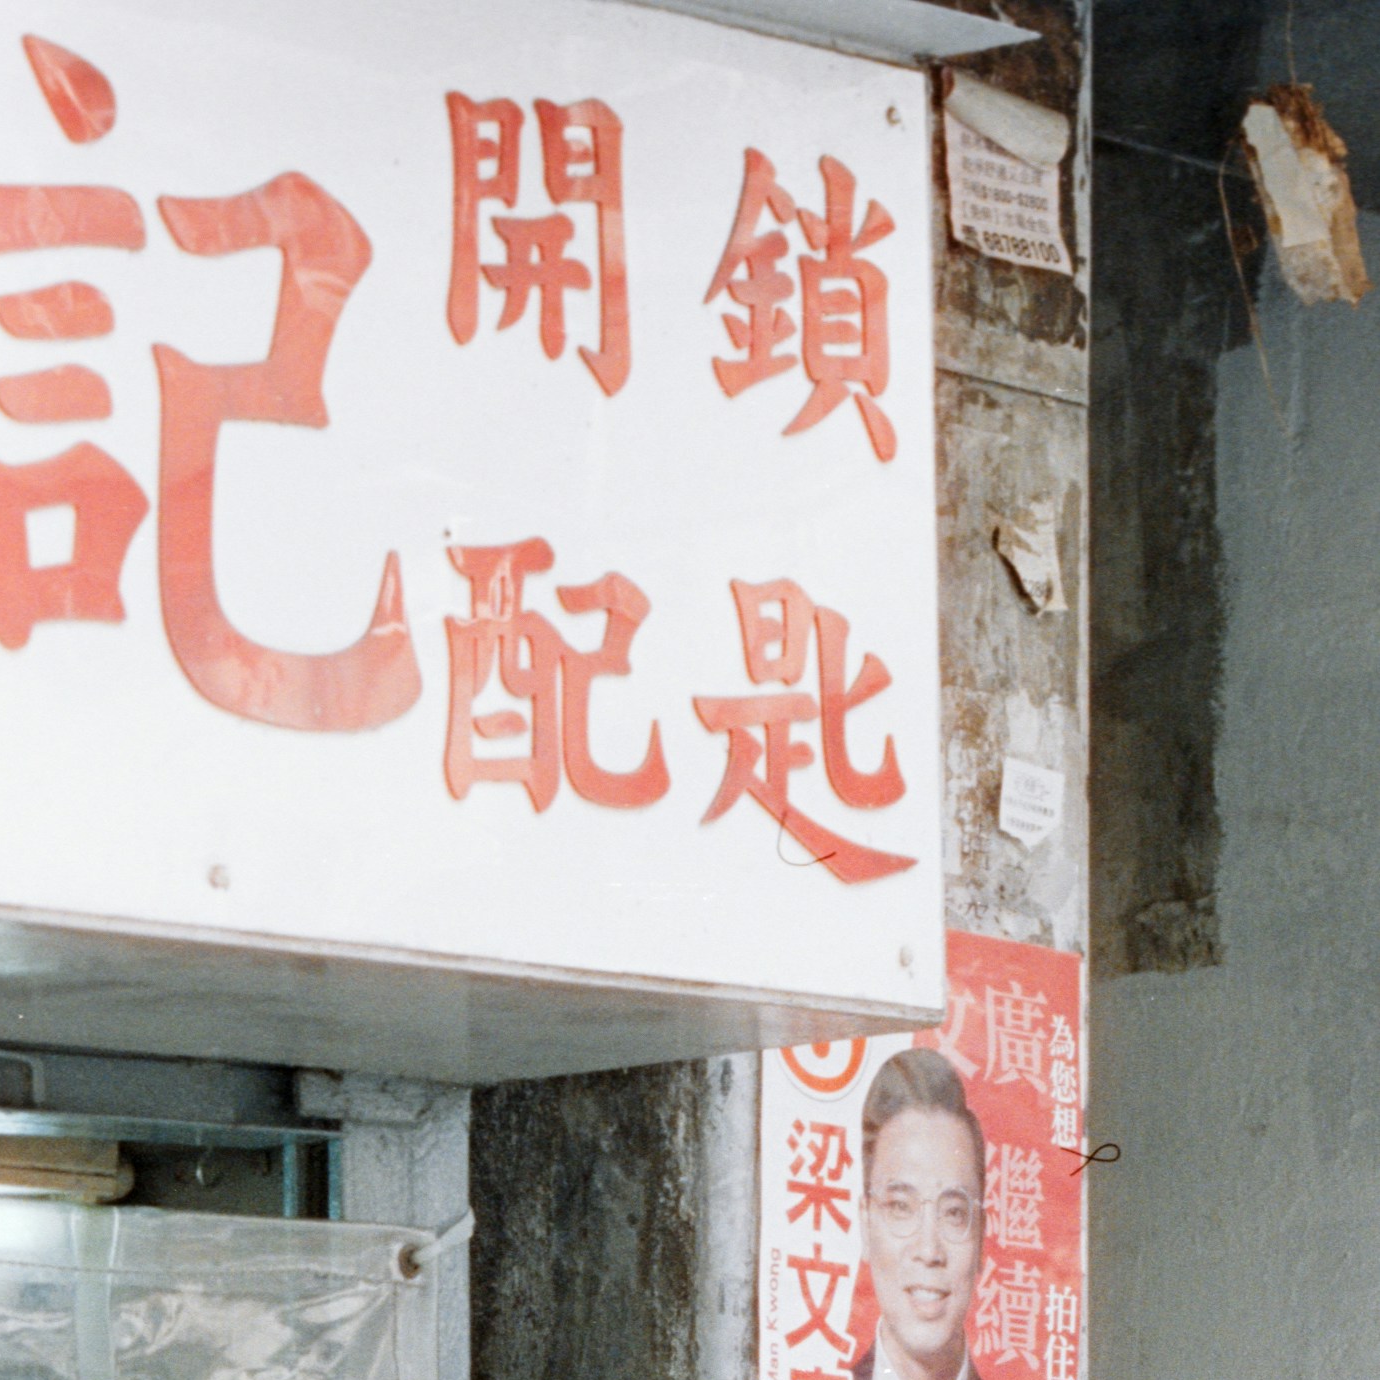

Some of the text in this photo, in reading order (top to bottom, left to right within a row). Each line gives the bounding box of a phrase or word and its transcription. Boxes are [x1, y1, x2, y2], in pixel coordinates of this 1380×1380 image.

[444, 91, 897, 464] 開鎖
[443, 536, 919, 884] 配匙
[1049, 1015, 1077, 1148] 為您想
[766, 1247, 781, 1331] Kwong
[974, 1141, 1044, 1371] 繼續
